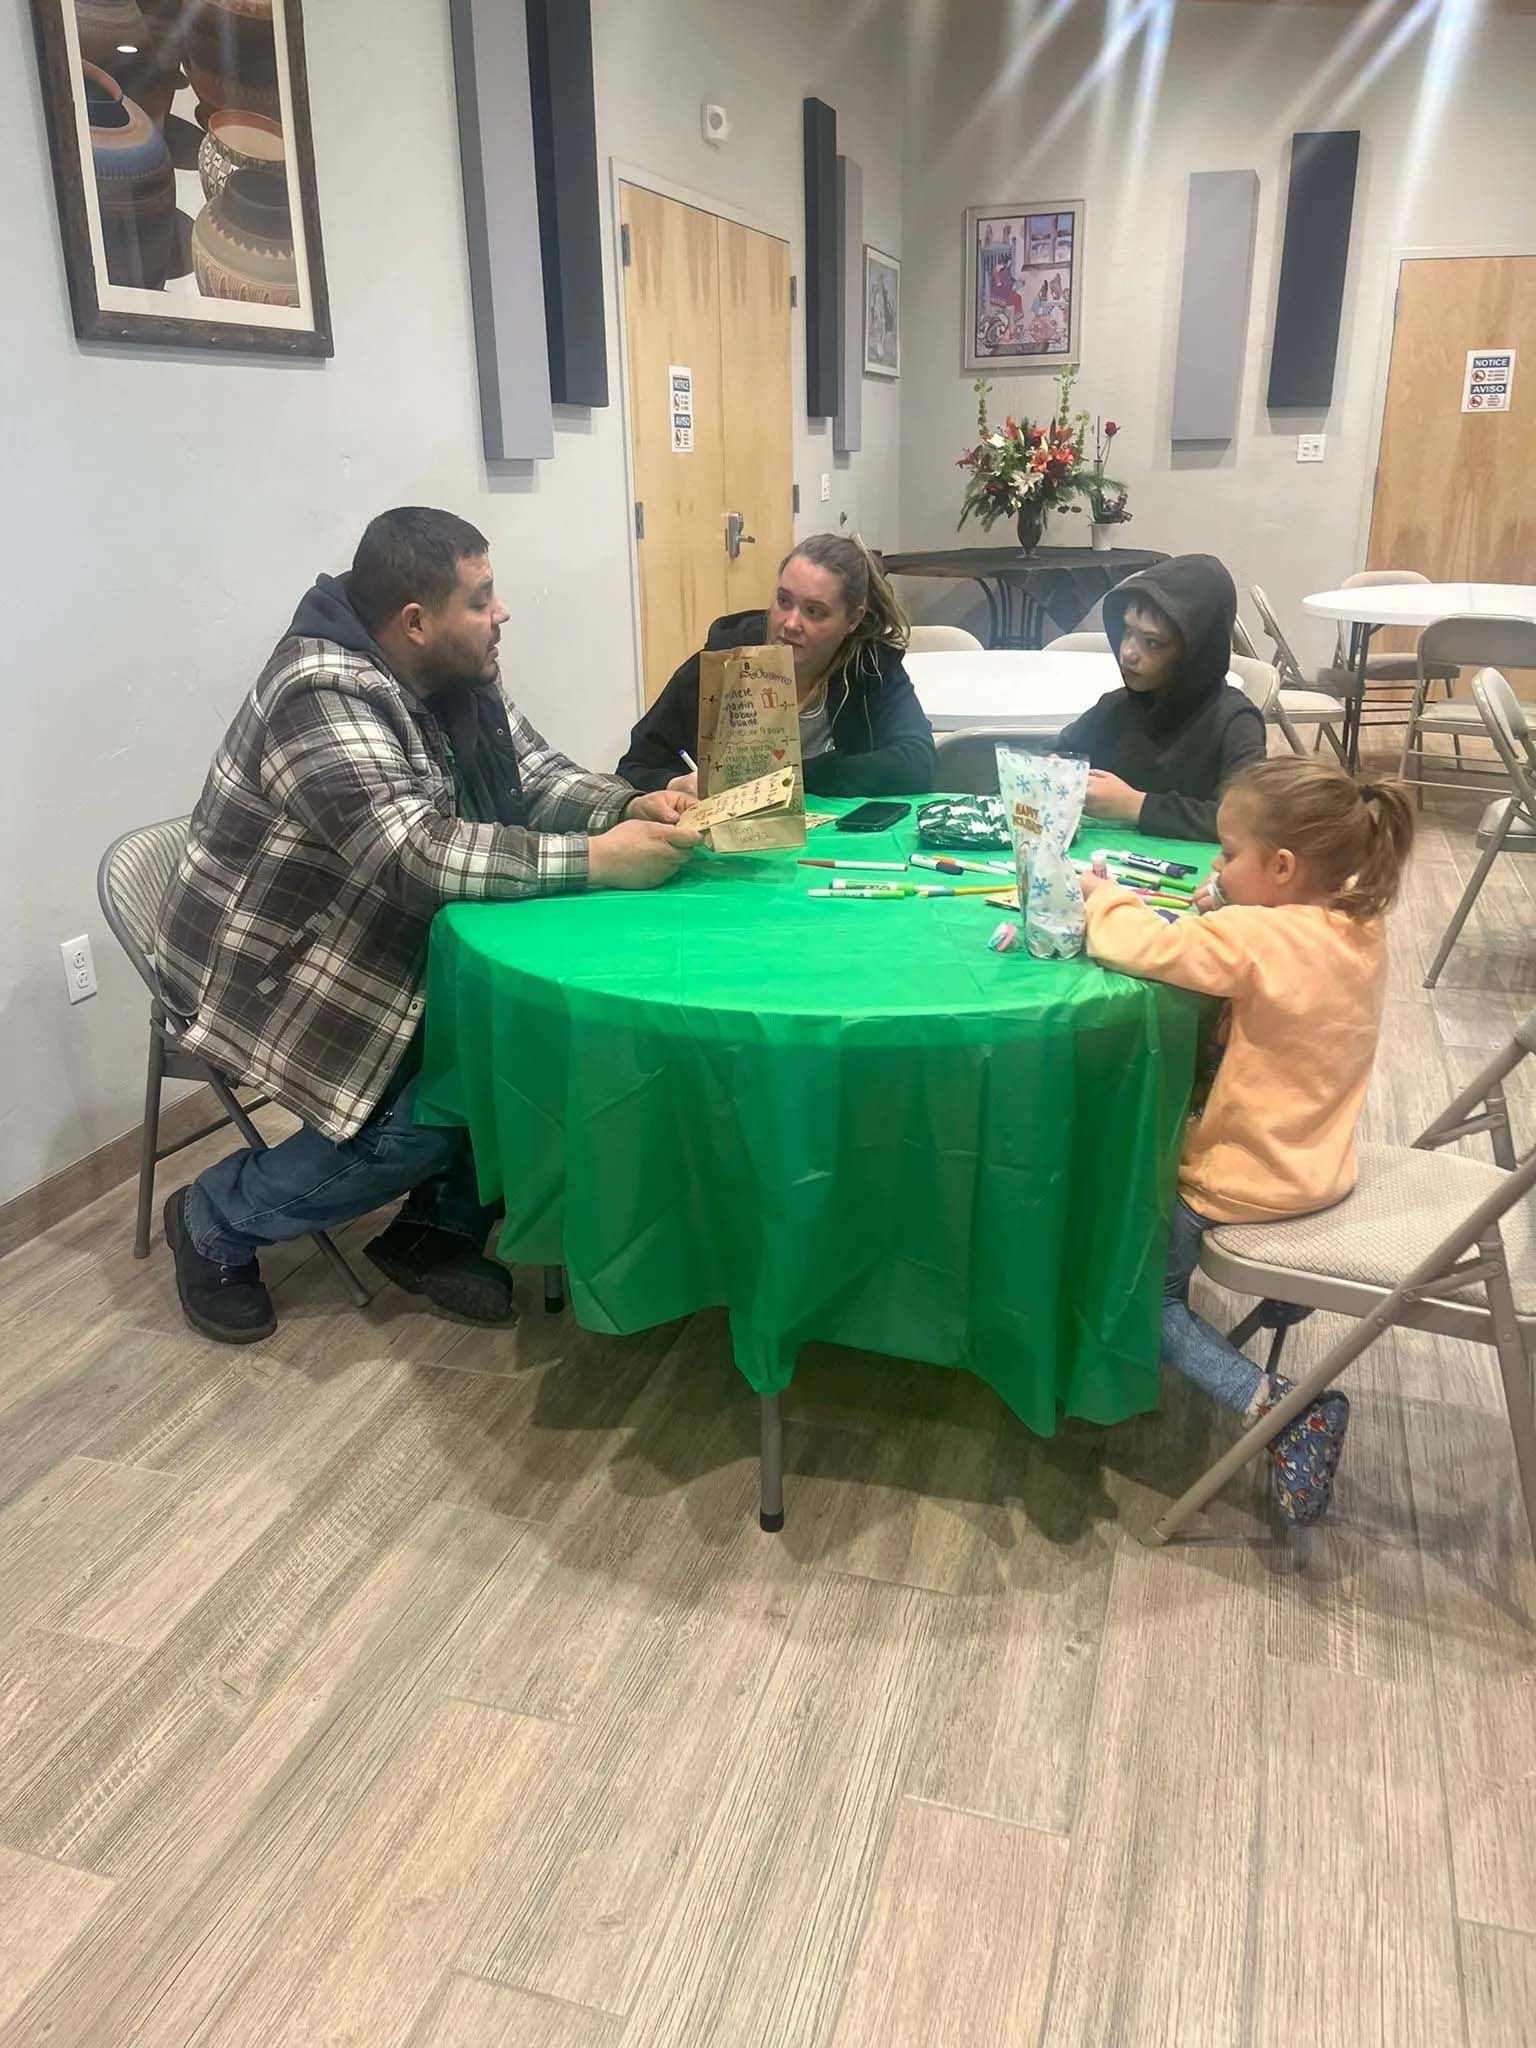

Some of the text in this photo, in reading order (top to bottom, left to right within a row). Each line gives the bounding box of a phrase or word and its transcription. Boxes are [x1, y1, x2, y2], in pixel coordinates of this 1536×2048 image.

[1475, 358, 1508, 367] NOTICE
[674, 379, 689, 390] NOTICE
[1472, 385, 1505, 393] AVISO
